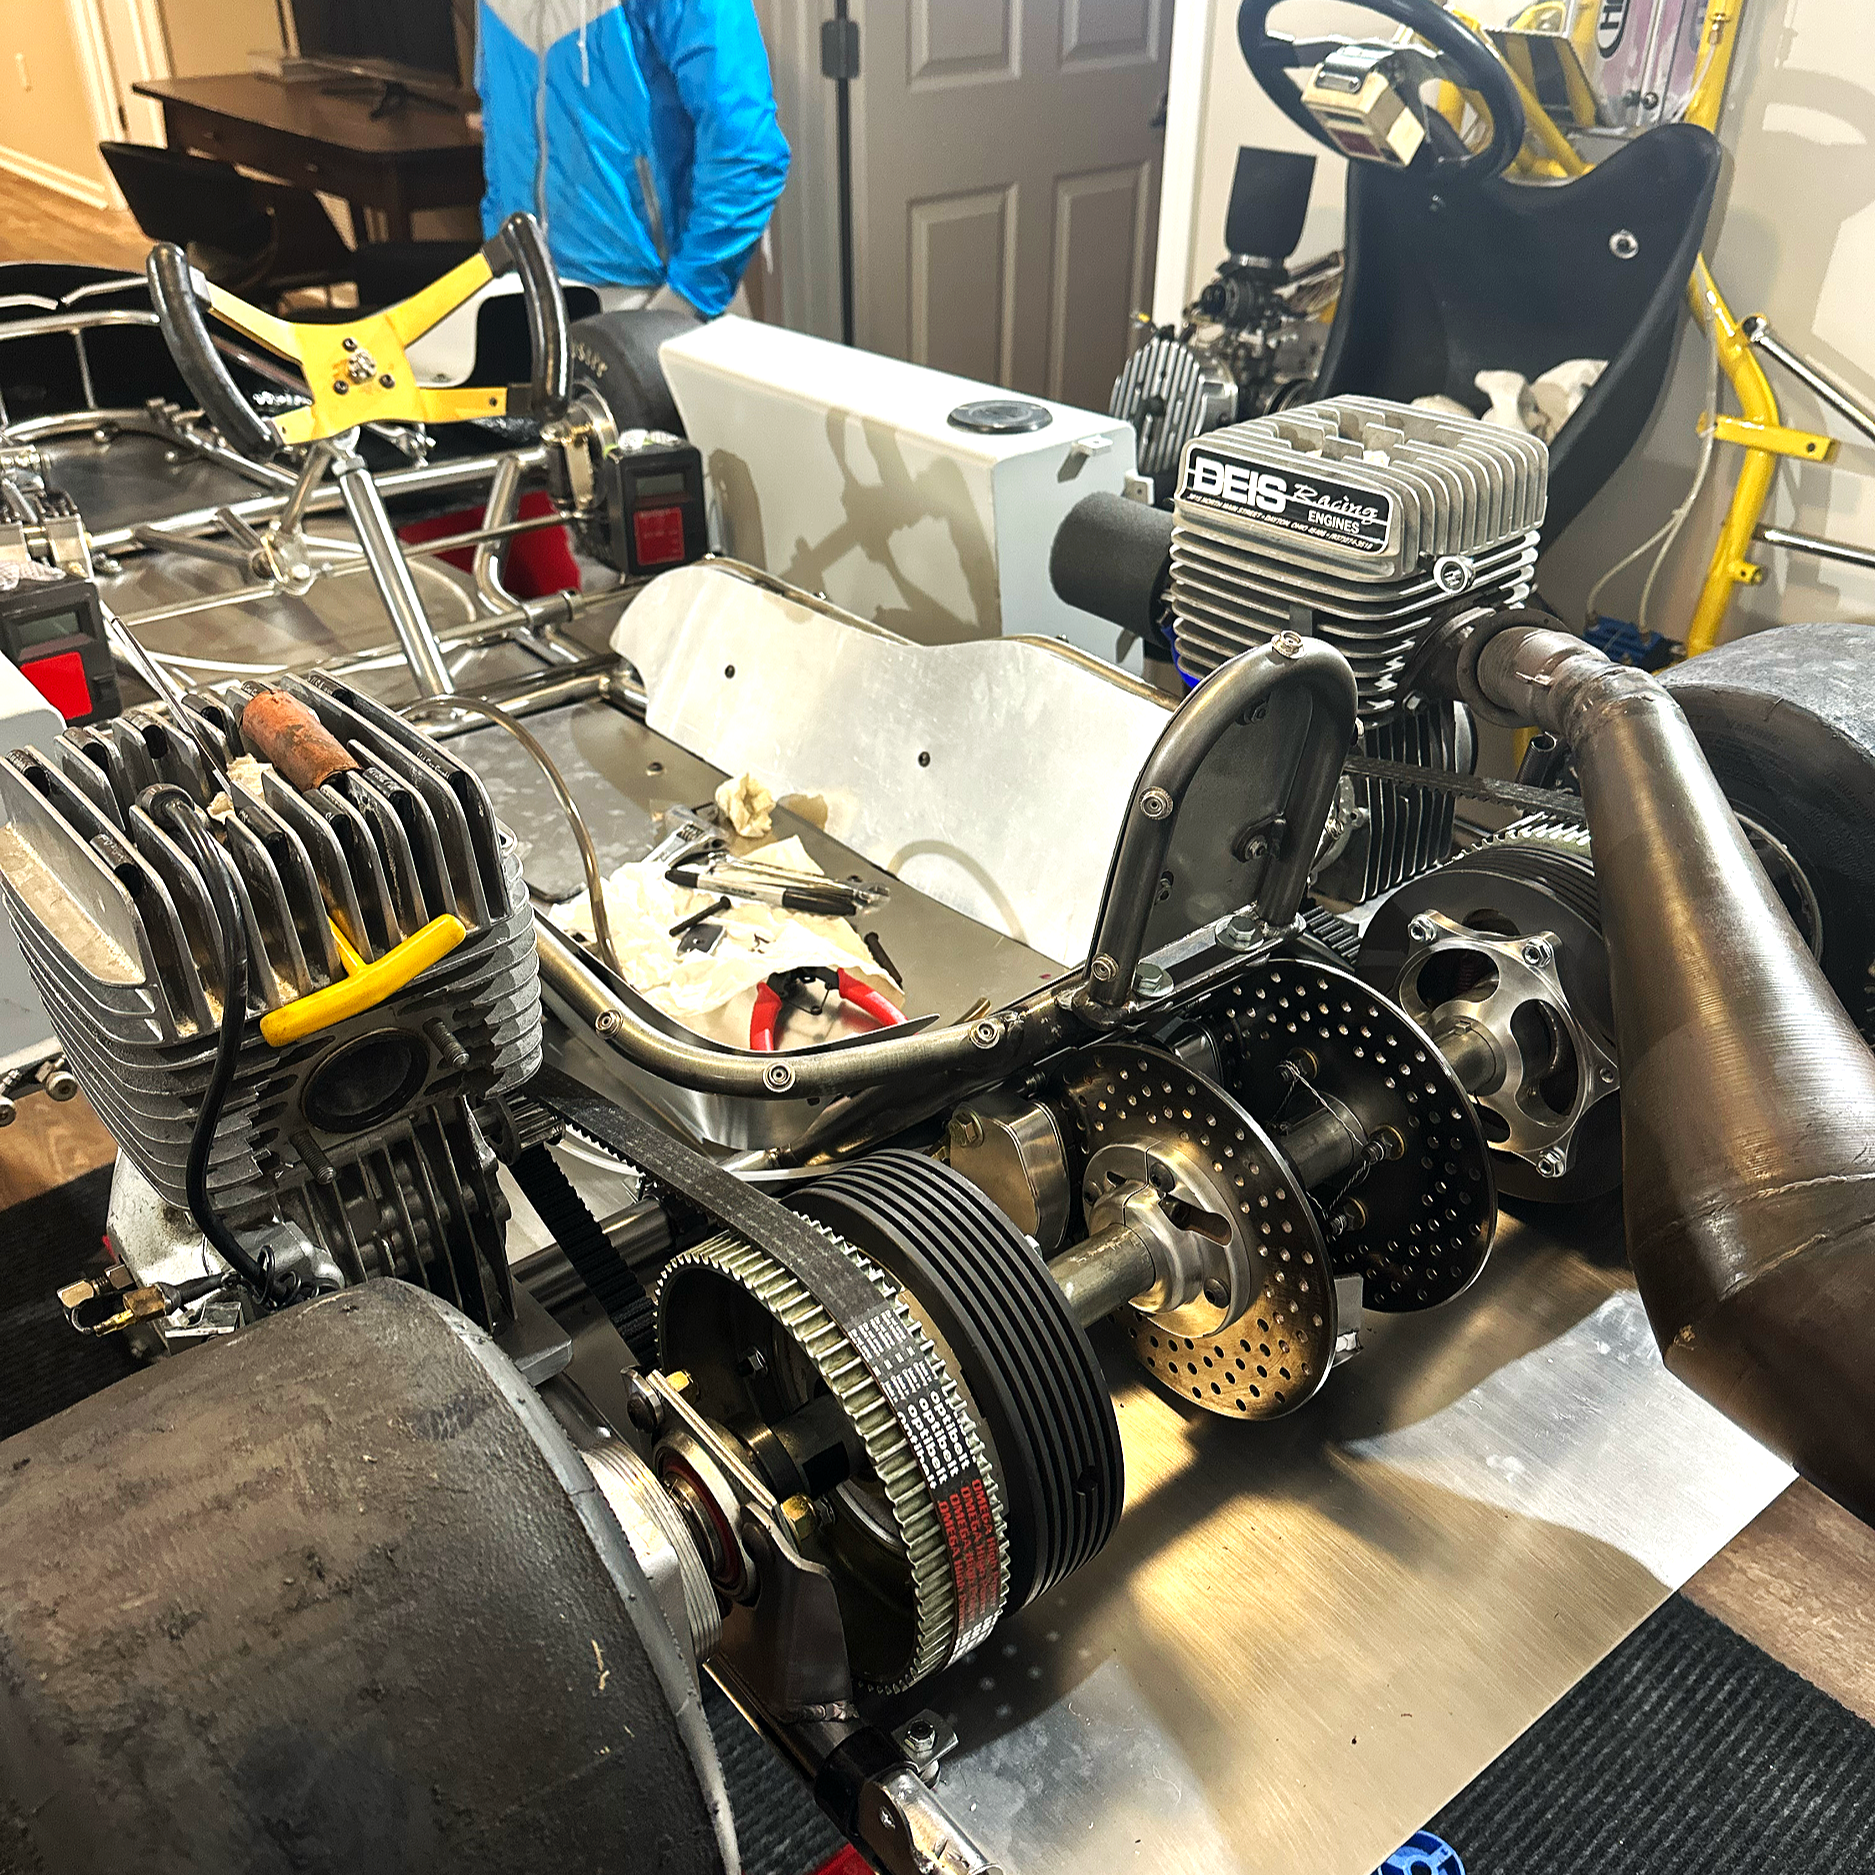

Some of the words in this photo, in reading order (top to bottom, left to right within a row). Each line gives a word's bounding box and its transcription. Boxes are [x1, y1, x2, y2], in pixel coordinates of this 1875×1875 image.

[1193, 456, 1287, 514] DEIS
[1293, 483, 1379, 525] Racing
[1307, 510, 1360, 534] ENGINES
[908, 1404, 947, 1486] optibelt
[918, 1397, 959, 1477] optibelt
[929, 1390, 970, 1470] optibelt
[939, 1500, 960, 1558] OMEGA
[949, 1493, 971, 1550] OMEGA
[960, 1486, 982, 1542] OMEGA
[972, 1479, 994, 1534] OMEGA
